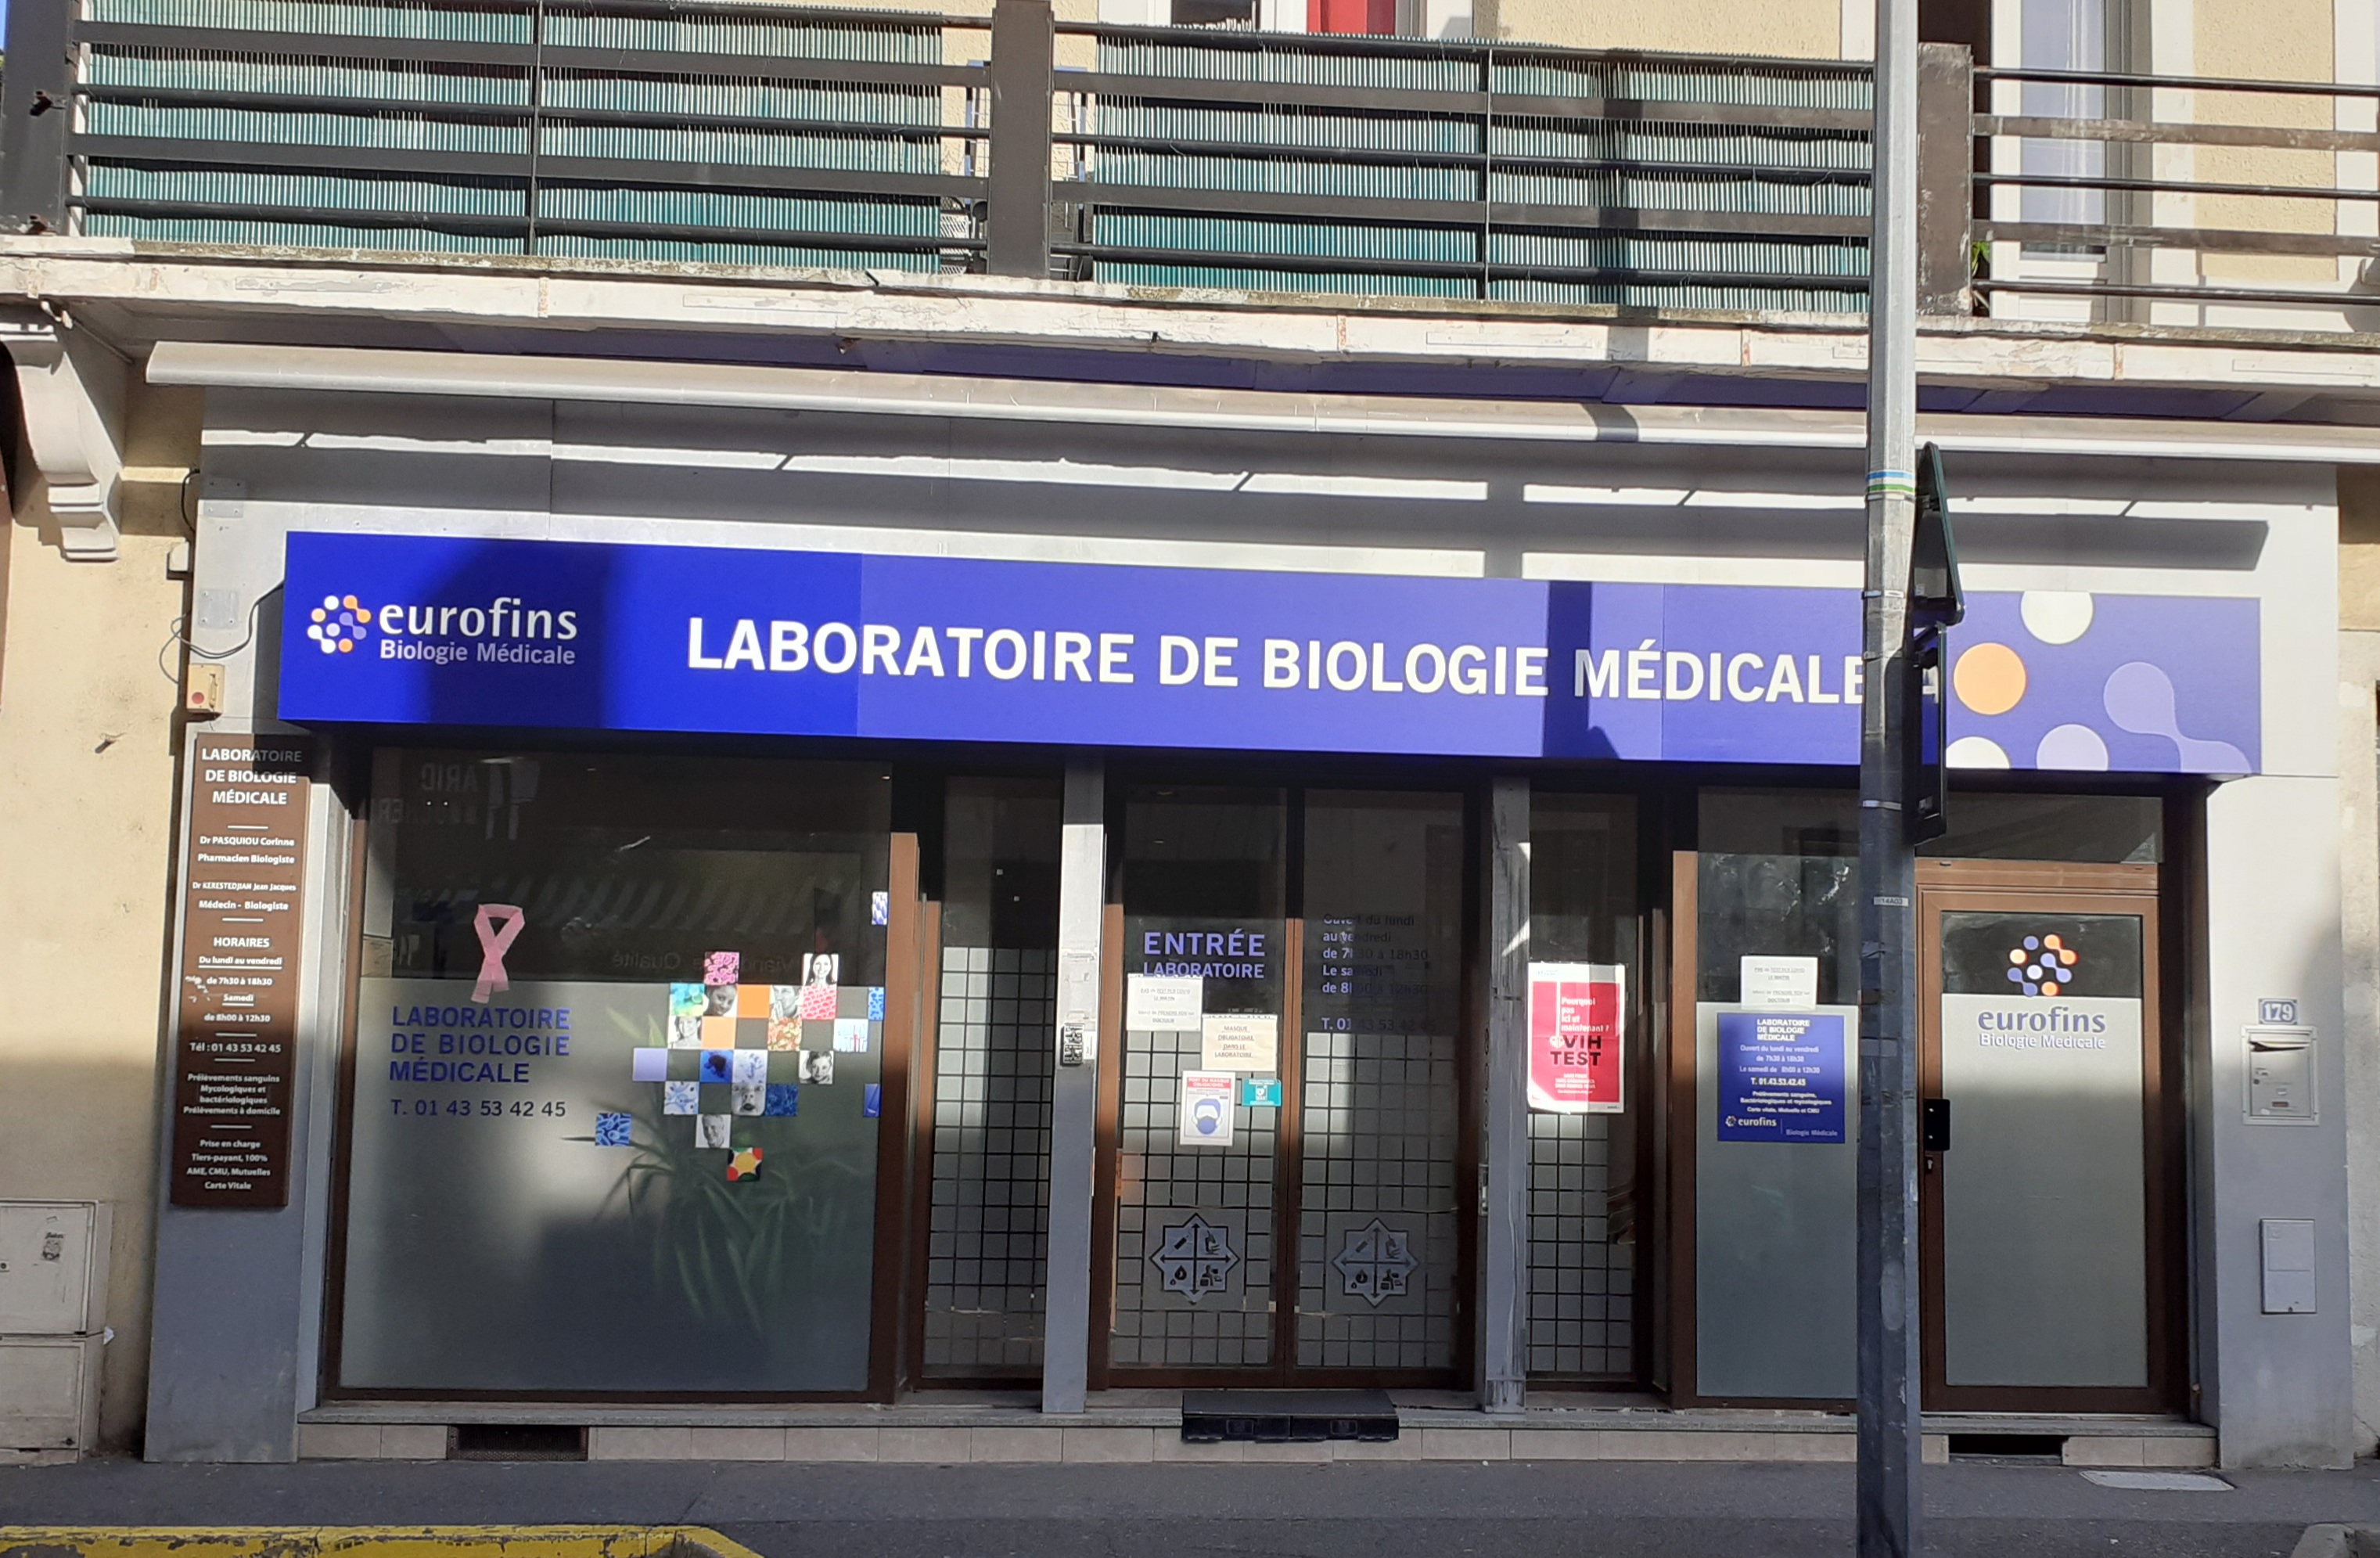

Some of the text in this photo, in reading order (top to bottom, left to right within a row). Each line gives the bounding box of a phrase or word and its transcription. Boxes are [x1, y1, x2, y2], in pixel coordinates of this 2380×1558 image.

[379, 596, 577, 641] eurofins
[379, 639, 577, 665] Biologie Médicale
[688, 617, 1134, 683] LABORATOIRE
[1159, 635, 1239, 686] DE
[1263, 639, 1549, 696] BIOLOGIE
[1573, 639, 1863, 704] MÉDICALE
[202, 748, 302, 762] LABORATOIRE
[205, 769, 297, 783] DE BIOLOGIE
[212, 789, 287, 804] MÉDICALE
[200, 836, 295, 846] Dr PASQUIOU Corinne
[198, 854, 295, 865] Pharmacien Biologiste
[270, 883, 297, 892] Jacques
[199, 900, 236, 909] Médecin
[244, 901, 289, 912] Biologiste
[214, 937, 270, 948] HORAIRES
[1323, 933, 1337, 941] au
[1144, 929, 1266, 957] ENTRÉE
[1323, 948, 1337, 959] de
[1143, 962, 1264, 979] LABORATOIRE
[1323, 965, 1337, 976] Le
[240, 977, 246, 985] à
[246, 977, 272, 986] 18h30
[1322, 982, 1336, 993] de
[223, 993, 253, 1002] Samedi
[1562, 997, 1595, 1006] Pourquoi
[2263, 1002, 2294, 1021] 179
[246, 1014, 271, 1023] 12h30
[392, 1006, 570, 1030] LABORATOIRE
[1978, 1006, 2106, 1033] eurofins
[1562, 1024, 1603, 1032] maintenant
[391, 1033, 570, 1056] DE BIOLOGIE
[1563, 1035, 1602, 1049] VIH
[1979, 1032, 2037, 1049] Biologie
[189, 1042, 205, 1052] Tél
[211, 1043, 223, 1052] 01
[226, 1043, 239, 1052] 43
[240, 1044, 253, 1052] 53
[254, 1044, 267, 1053] 42
[268, 1044, 282, 1053] 45
[1550, 1051, 1602, 1066] TEST
[390, 1056, 530, 1083] MÉDICALE
[188, 1074, 280, 1084] Prélèvements sanguins
[200, 1085, 257, 1095] Mycologiques
[200, 1096, 268, 1106] bactériologiques
[239, 1106, 244, 1115] à
[391, 1099, 566, 1117] T. 01 43 53 42 45
[1738, 1117, 1778, 1126] eurofins
[200, 1139, 220, 1148] Prise
[233, 1140, 261, 1150] charge
